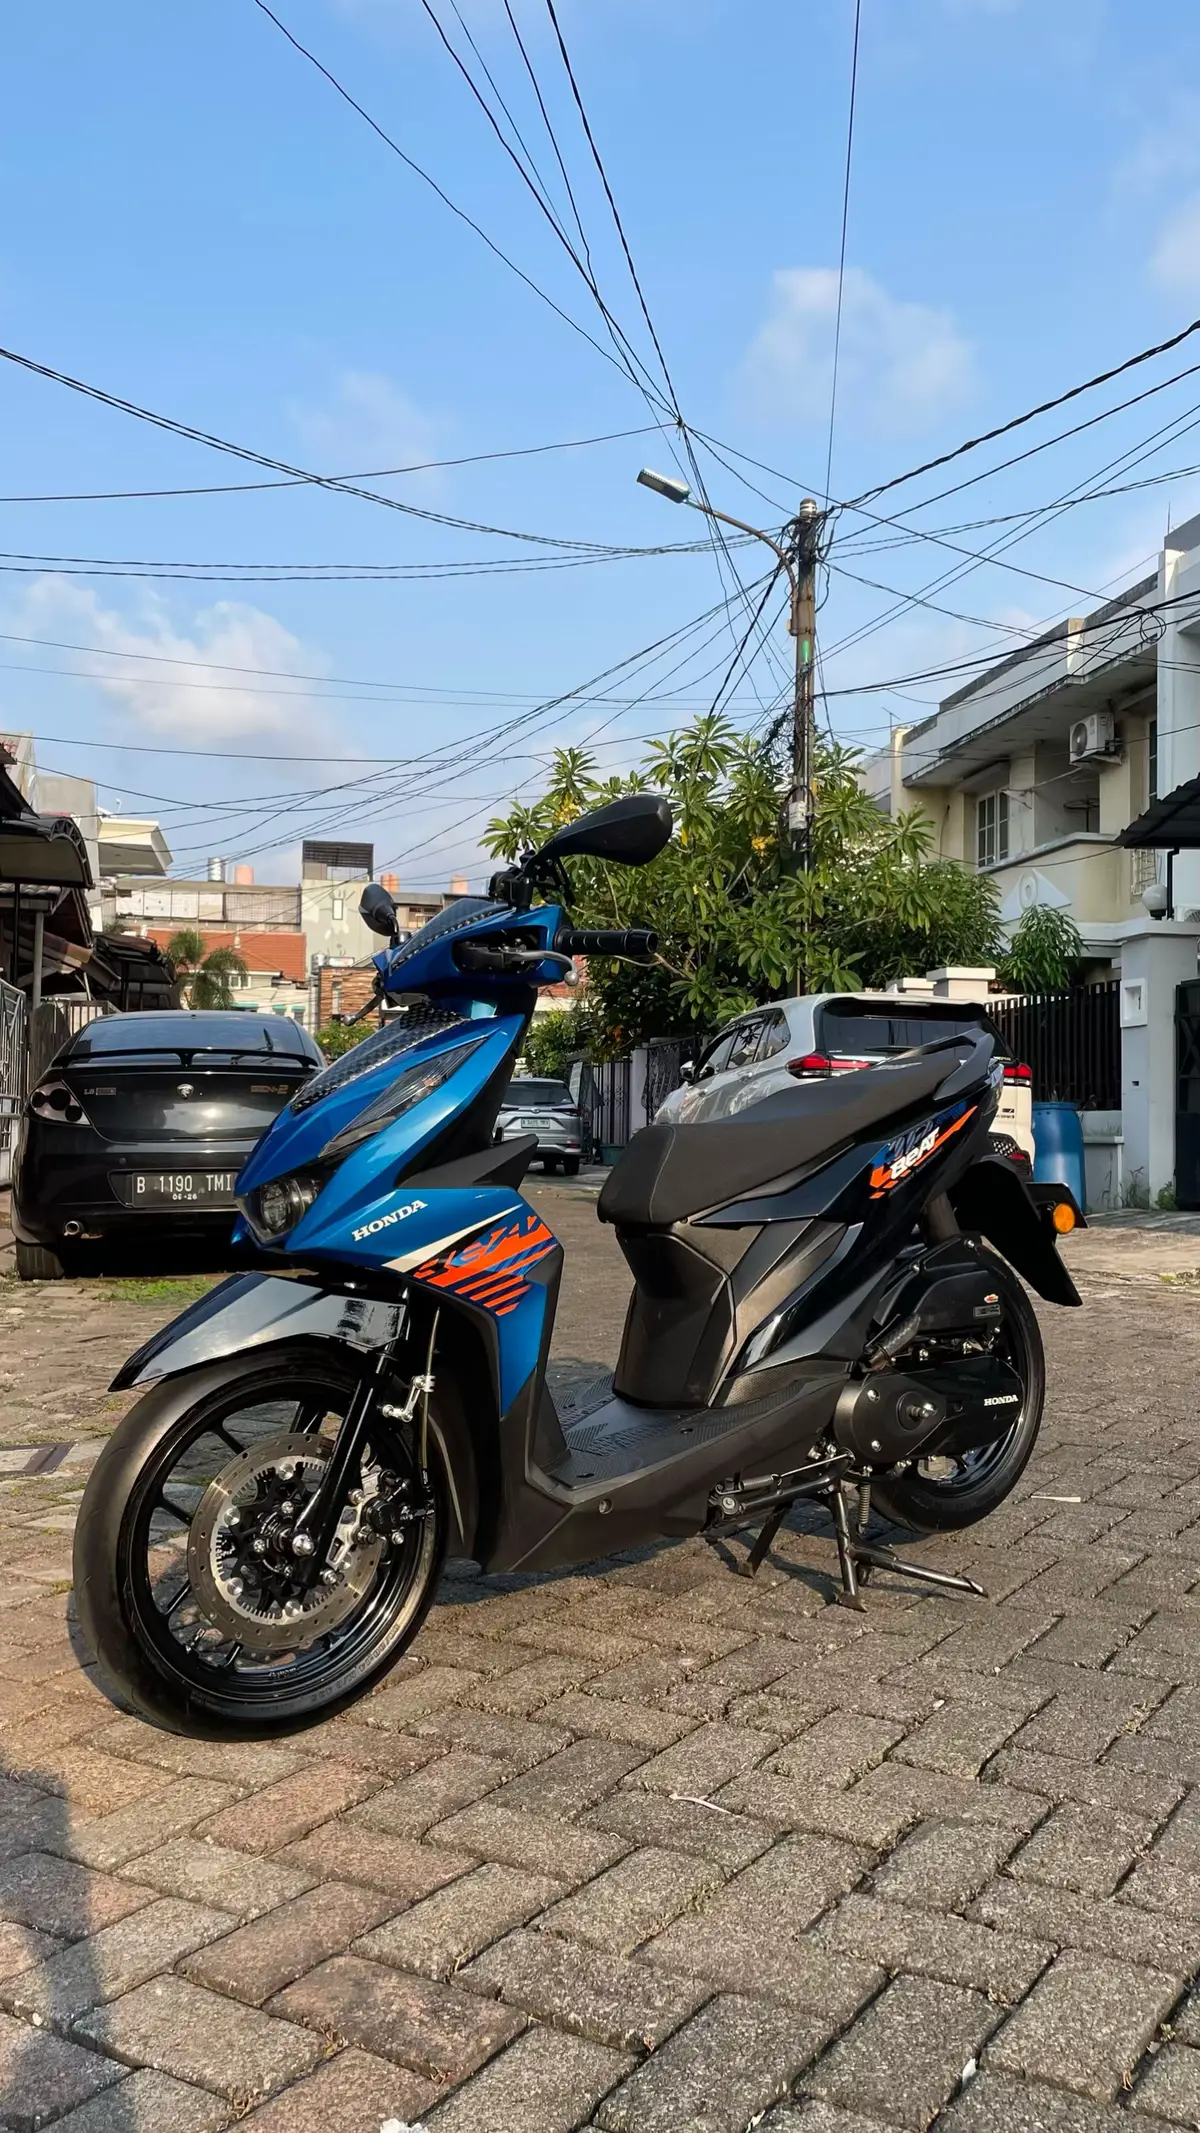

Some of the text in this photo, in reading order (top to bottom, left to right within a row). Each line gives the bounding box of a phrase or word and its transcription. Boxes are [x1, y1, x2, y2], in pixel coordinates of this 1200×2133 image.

[136, 1174, 232, 1194] B 1190 TMI
[351, 1199, 429, 1242] HONDA
[983, 1394, 1019, 1407] HONDA
